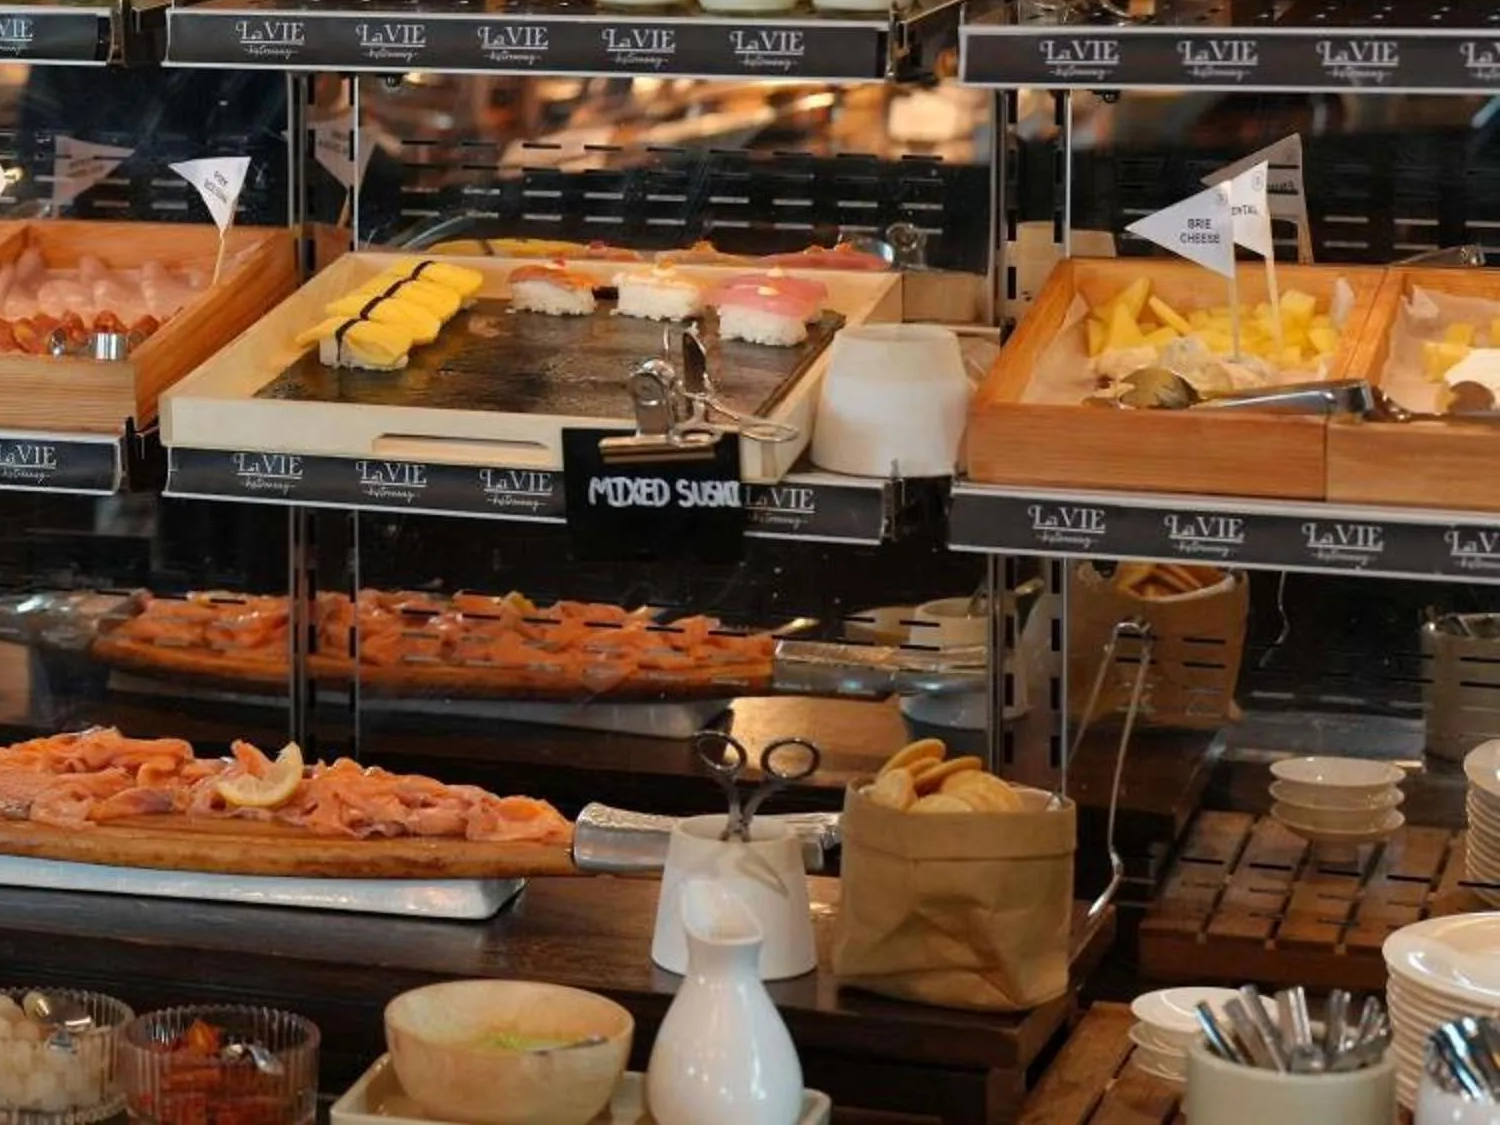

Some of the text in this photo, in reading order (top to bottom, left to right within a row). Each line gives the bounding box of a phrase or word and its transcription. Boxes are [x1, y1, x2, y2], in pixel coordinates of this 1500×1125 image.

[1188, 218, 1212, 230] BRIE
[1179, 232, 1220, 244] CHEESE
[589, 477, 670, 507] MIXED
